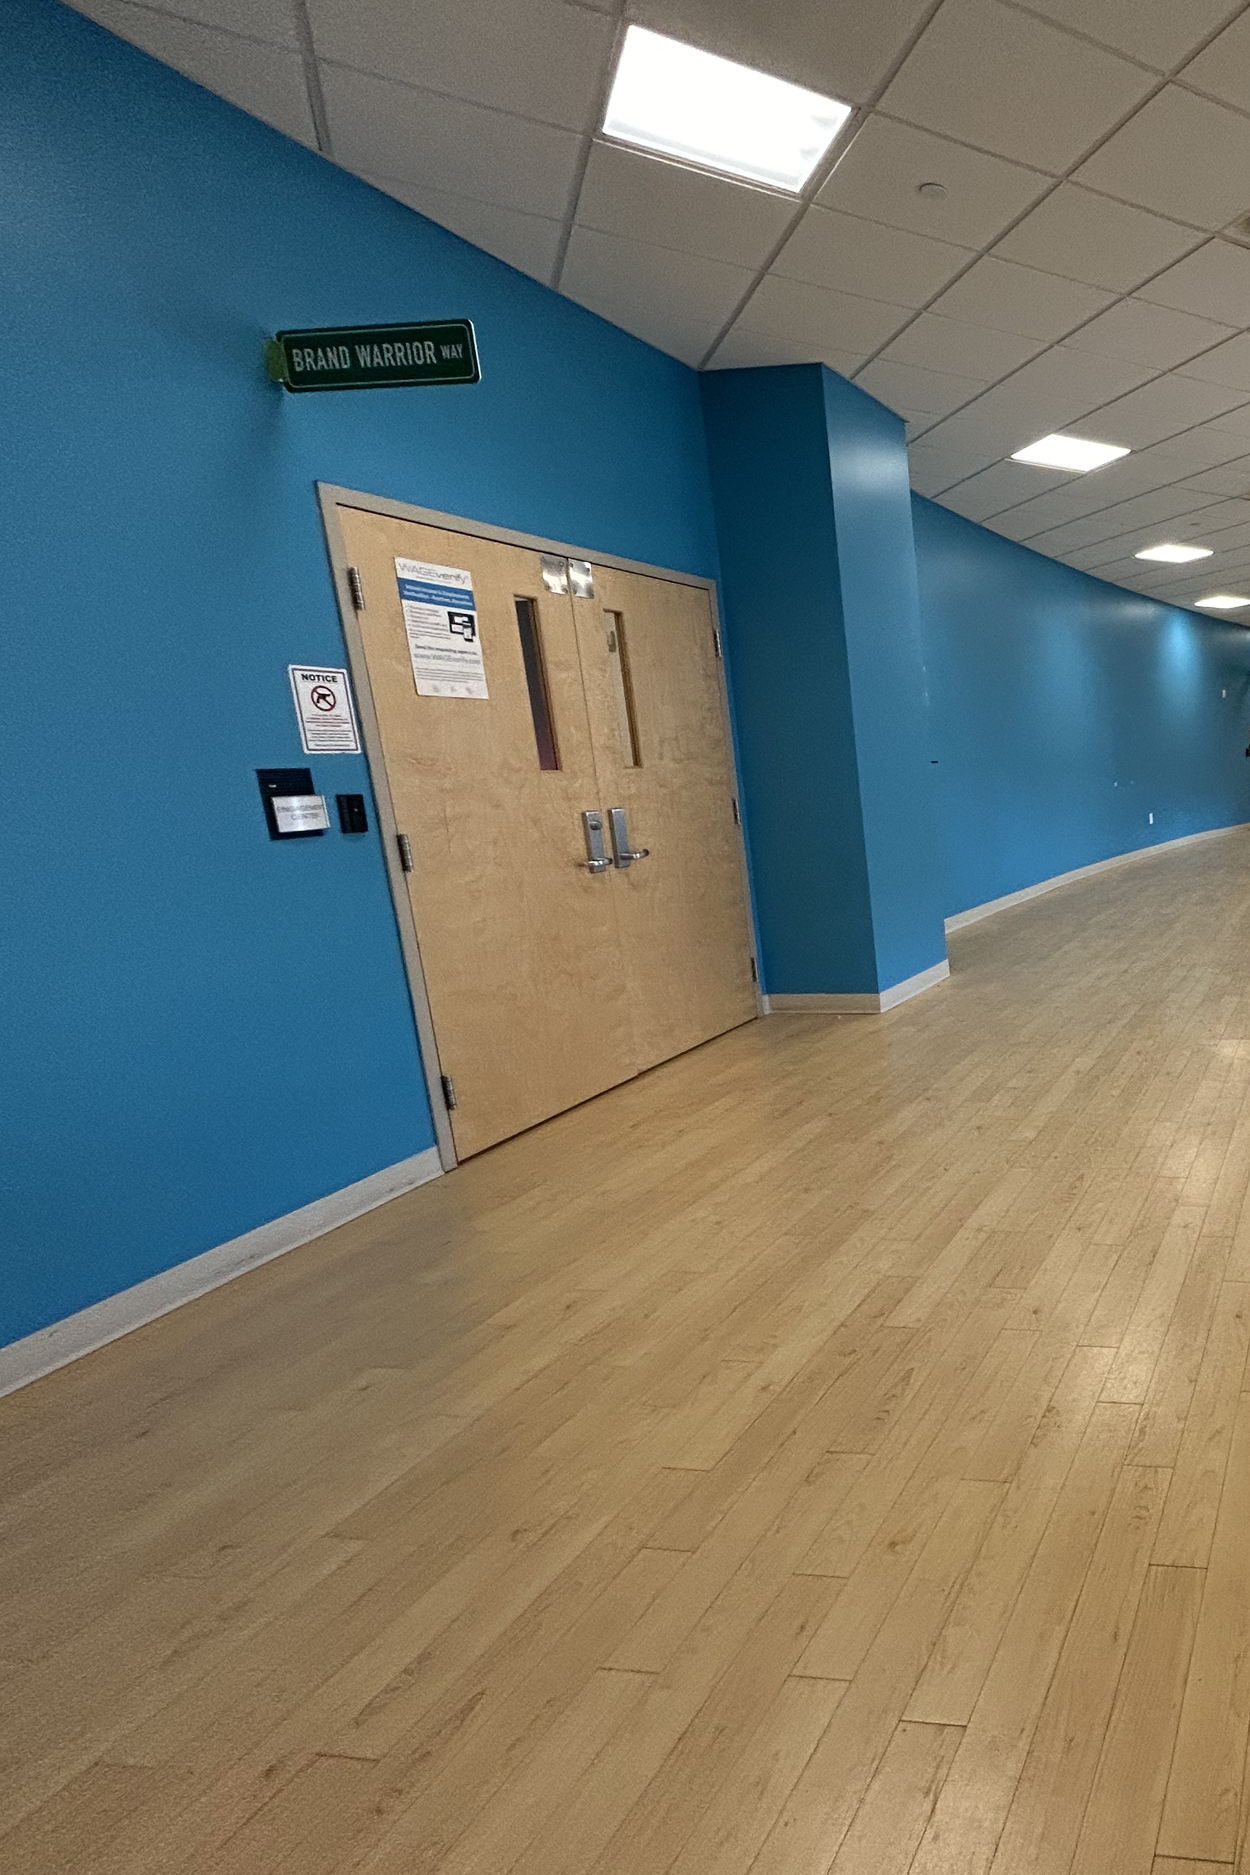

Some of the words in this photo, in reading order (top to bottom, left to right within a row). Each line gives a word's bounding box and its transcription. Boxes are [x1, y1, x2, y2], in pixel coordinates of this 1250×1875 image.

[292, 346, 350, 372] BRAND
[355, 341, 437, 368] WARRIOR
[440, 343, 464, 360] WAY
[301, 673, 338, 683] NOTICE
